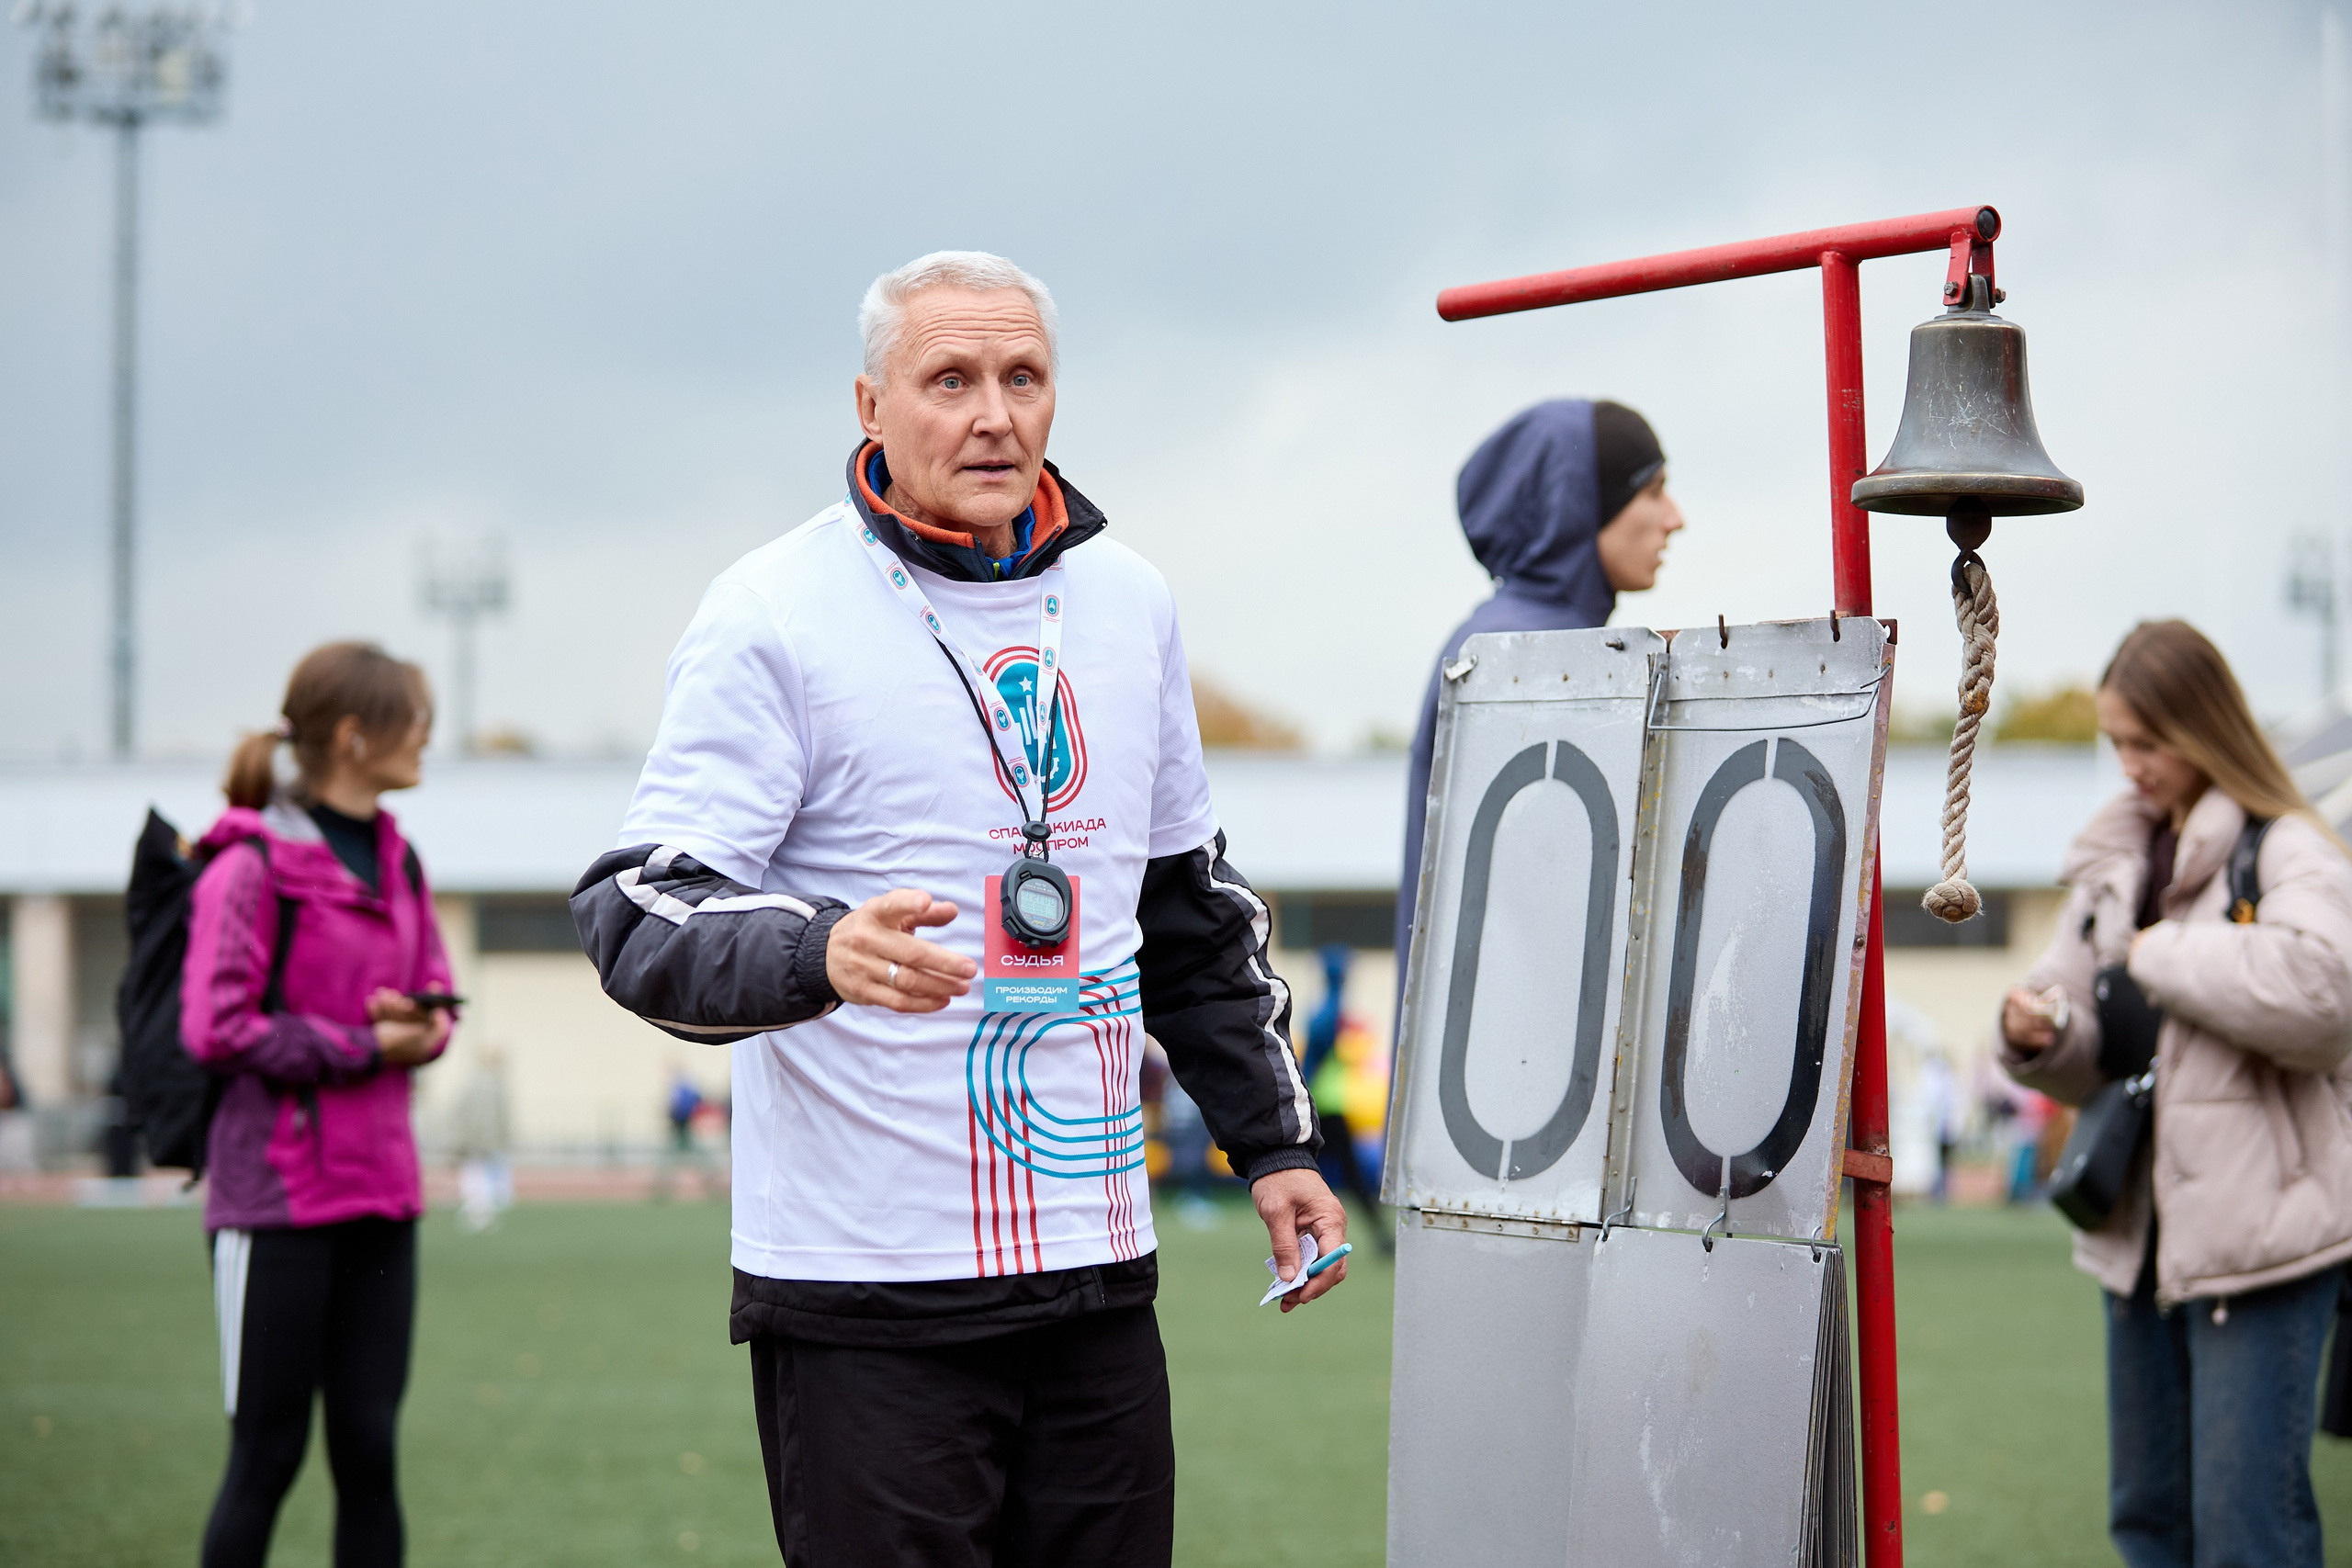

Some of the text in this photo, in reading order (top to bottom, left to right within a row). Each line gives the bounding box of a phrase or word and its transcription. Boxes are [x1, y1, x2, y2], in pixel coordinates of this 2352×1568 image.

[989, 818, 1106, 840] СПАКИАДА
[1001, 954, 1064, 967] СУДЬЯ
[995, 986, 1068, 995] ПРОИЗВОДИМ
[1005, 996, 1057, 1004] РЕКОРДЫ
